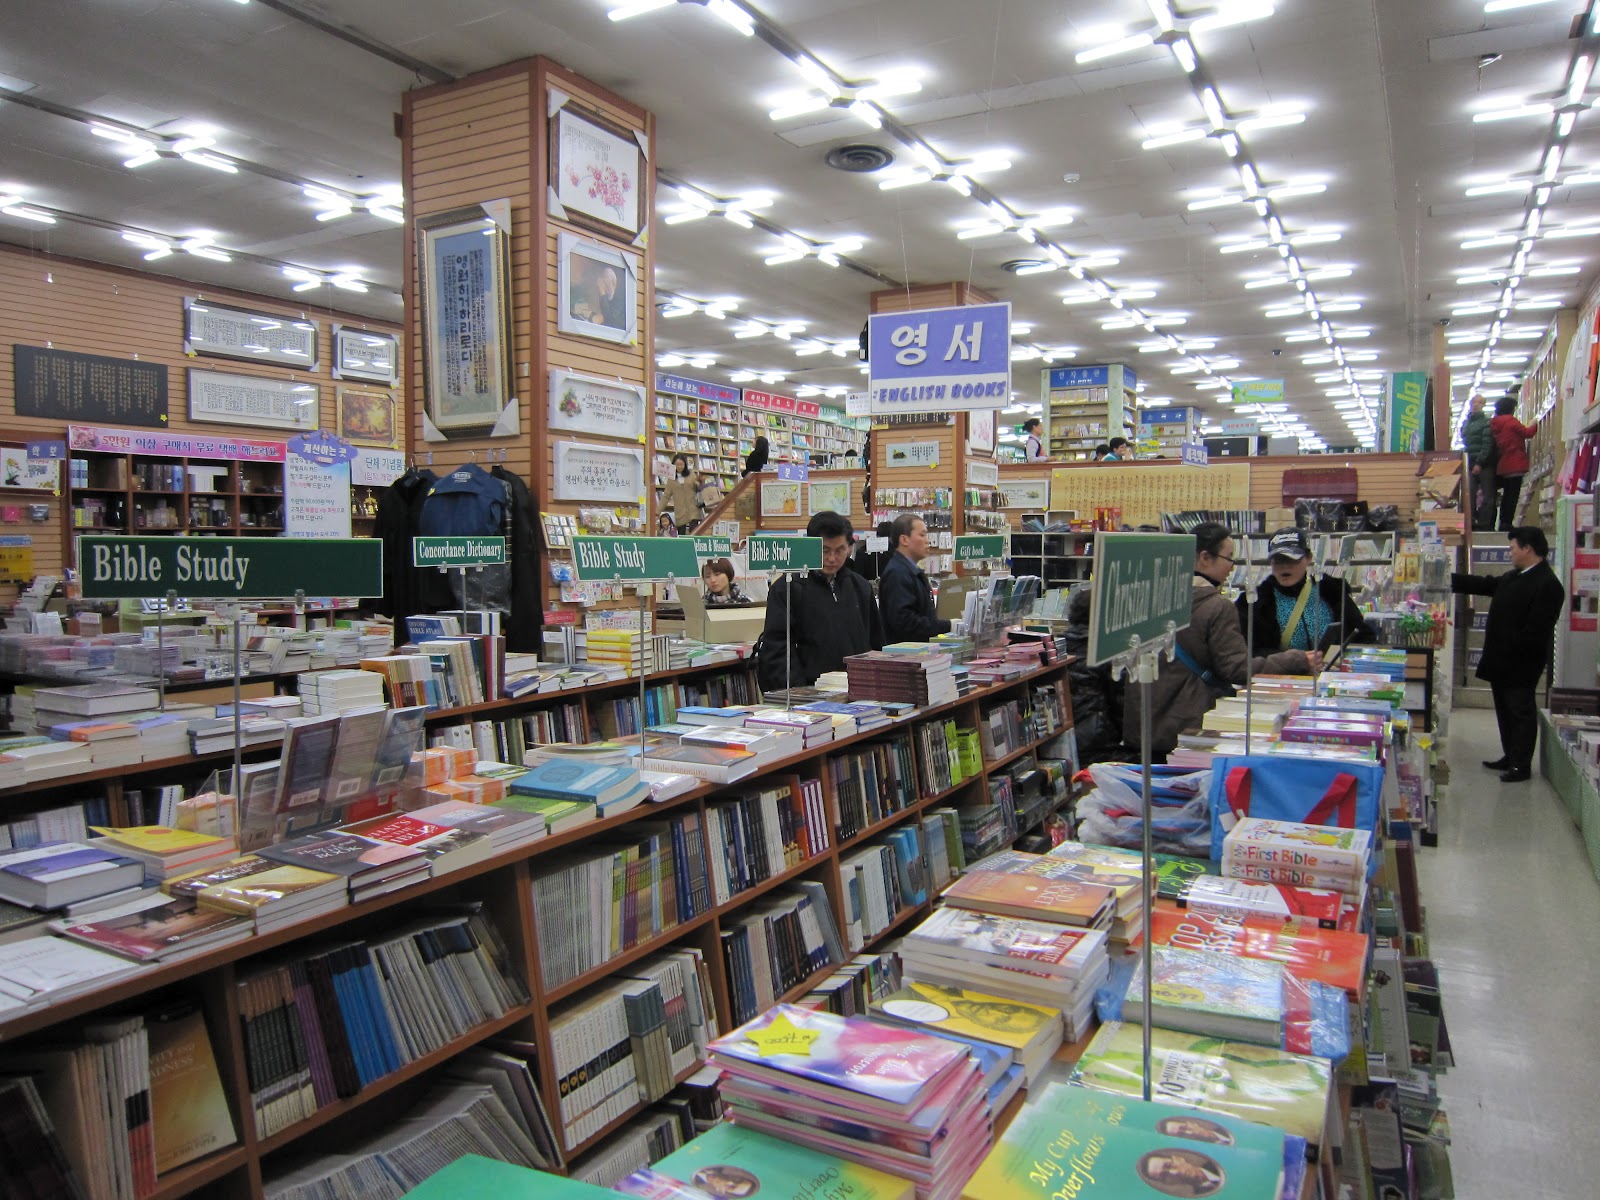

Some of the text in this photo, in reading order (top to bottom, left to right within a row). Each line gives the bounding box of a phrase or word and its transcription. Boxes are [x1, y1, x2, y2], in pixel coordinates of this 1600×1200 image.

[878, 381, 1006, 403] ENGLISH BOOKS
[102, 435, 131, 448] 5만원
[136, 438, 156, 449] 이상
[196, 442, 214, 453] 무료
[219, 443, 237, 454] 택배
[303, 443, 347, 458] 계산하는 곳
[365, 457, 380, 470] 단체
[419, 540, 502, 560] Concordance Dictionary
[713, 539, 730, 552] Mission
[751, 541, 791, 566] Bible Study
[960, 544, 985, 557] Gift book
[92, 544, 249, 590] Bible Study
[578, 541, 646, 574] Bible Study
[1105, 559, 1151, 635] Christian
[650, 763, 670, 772] Bible
[671, 764, 708, 777] Panorama
[1247, 846, 1279, 861] First
[1281, 849, 1318, 867] Bible
[1245, 864, 1276, 880] First
[1279, 867, 1316, 885] Bible
[1029, 1128, 1080, 1187] My Cup
